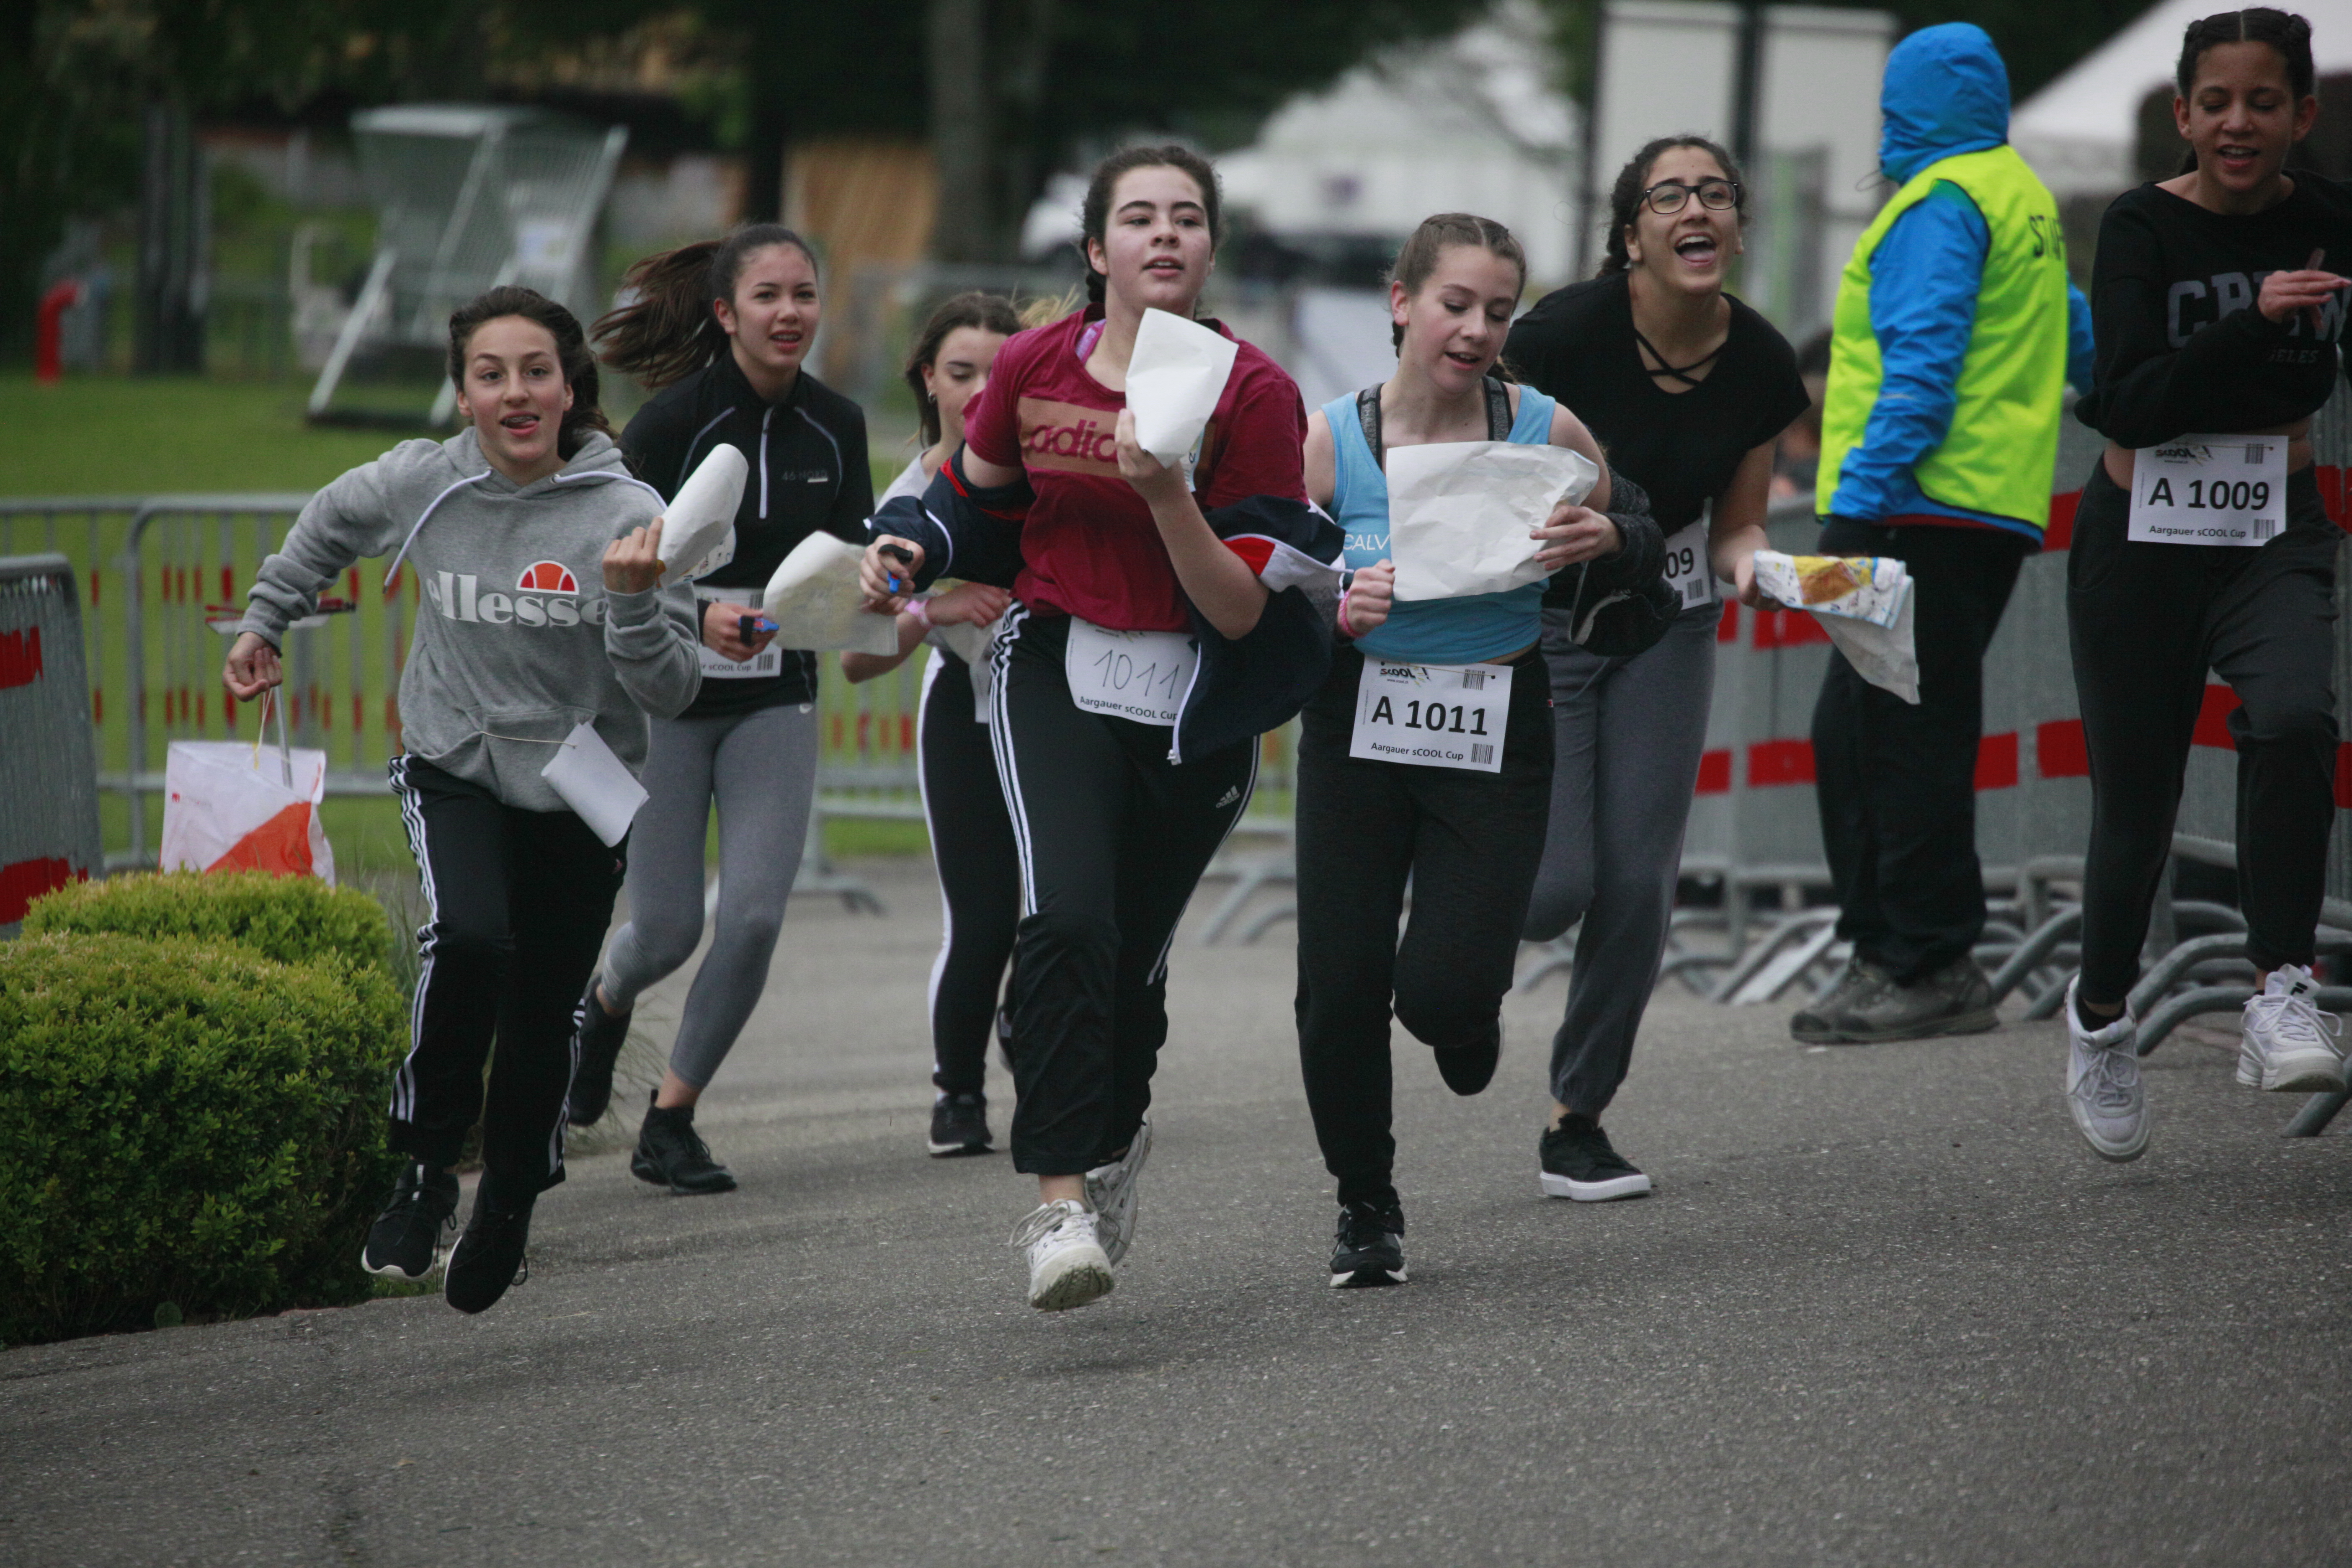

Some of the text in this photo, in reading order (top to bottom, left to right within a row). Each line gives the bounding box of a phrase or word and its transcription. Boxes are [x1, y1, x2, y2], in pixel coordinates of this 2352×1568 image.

[2148, 478, 2174, 506] A
[2187, 480, 2269, 510] 1009
[1343, 534, 1391, 550] CALV
[2149, 525, 2246, 539] Aargauer sCOOL Cup
[1665, 547, 1694, 579] 09
[426, 571, 606, 628] ellesse
[737, 664, 752, 672] Cup
[1093, 649, 1179, 699] 1011
[1080, 696, 1122, 710] Aargauer
[1125, 706, 1157, 719] sCOOL
[1371, 696, 1393, 725] A
[1405, 700, 1487, 736] 1011
[1371, 742, 1464, 761] Aargauer sCOOL Cup
